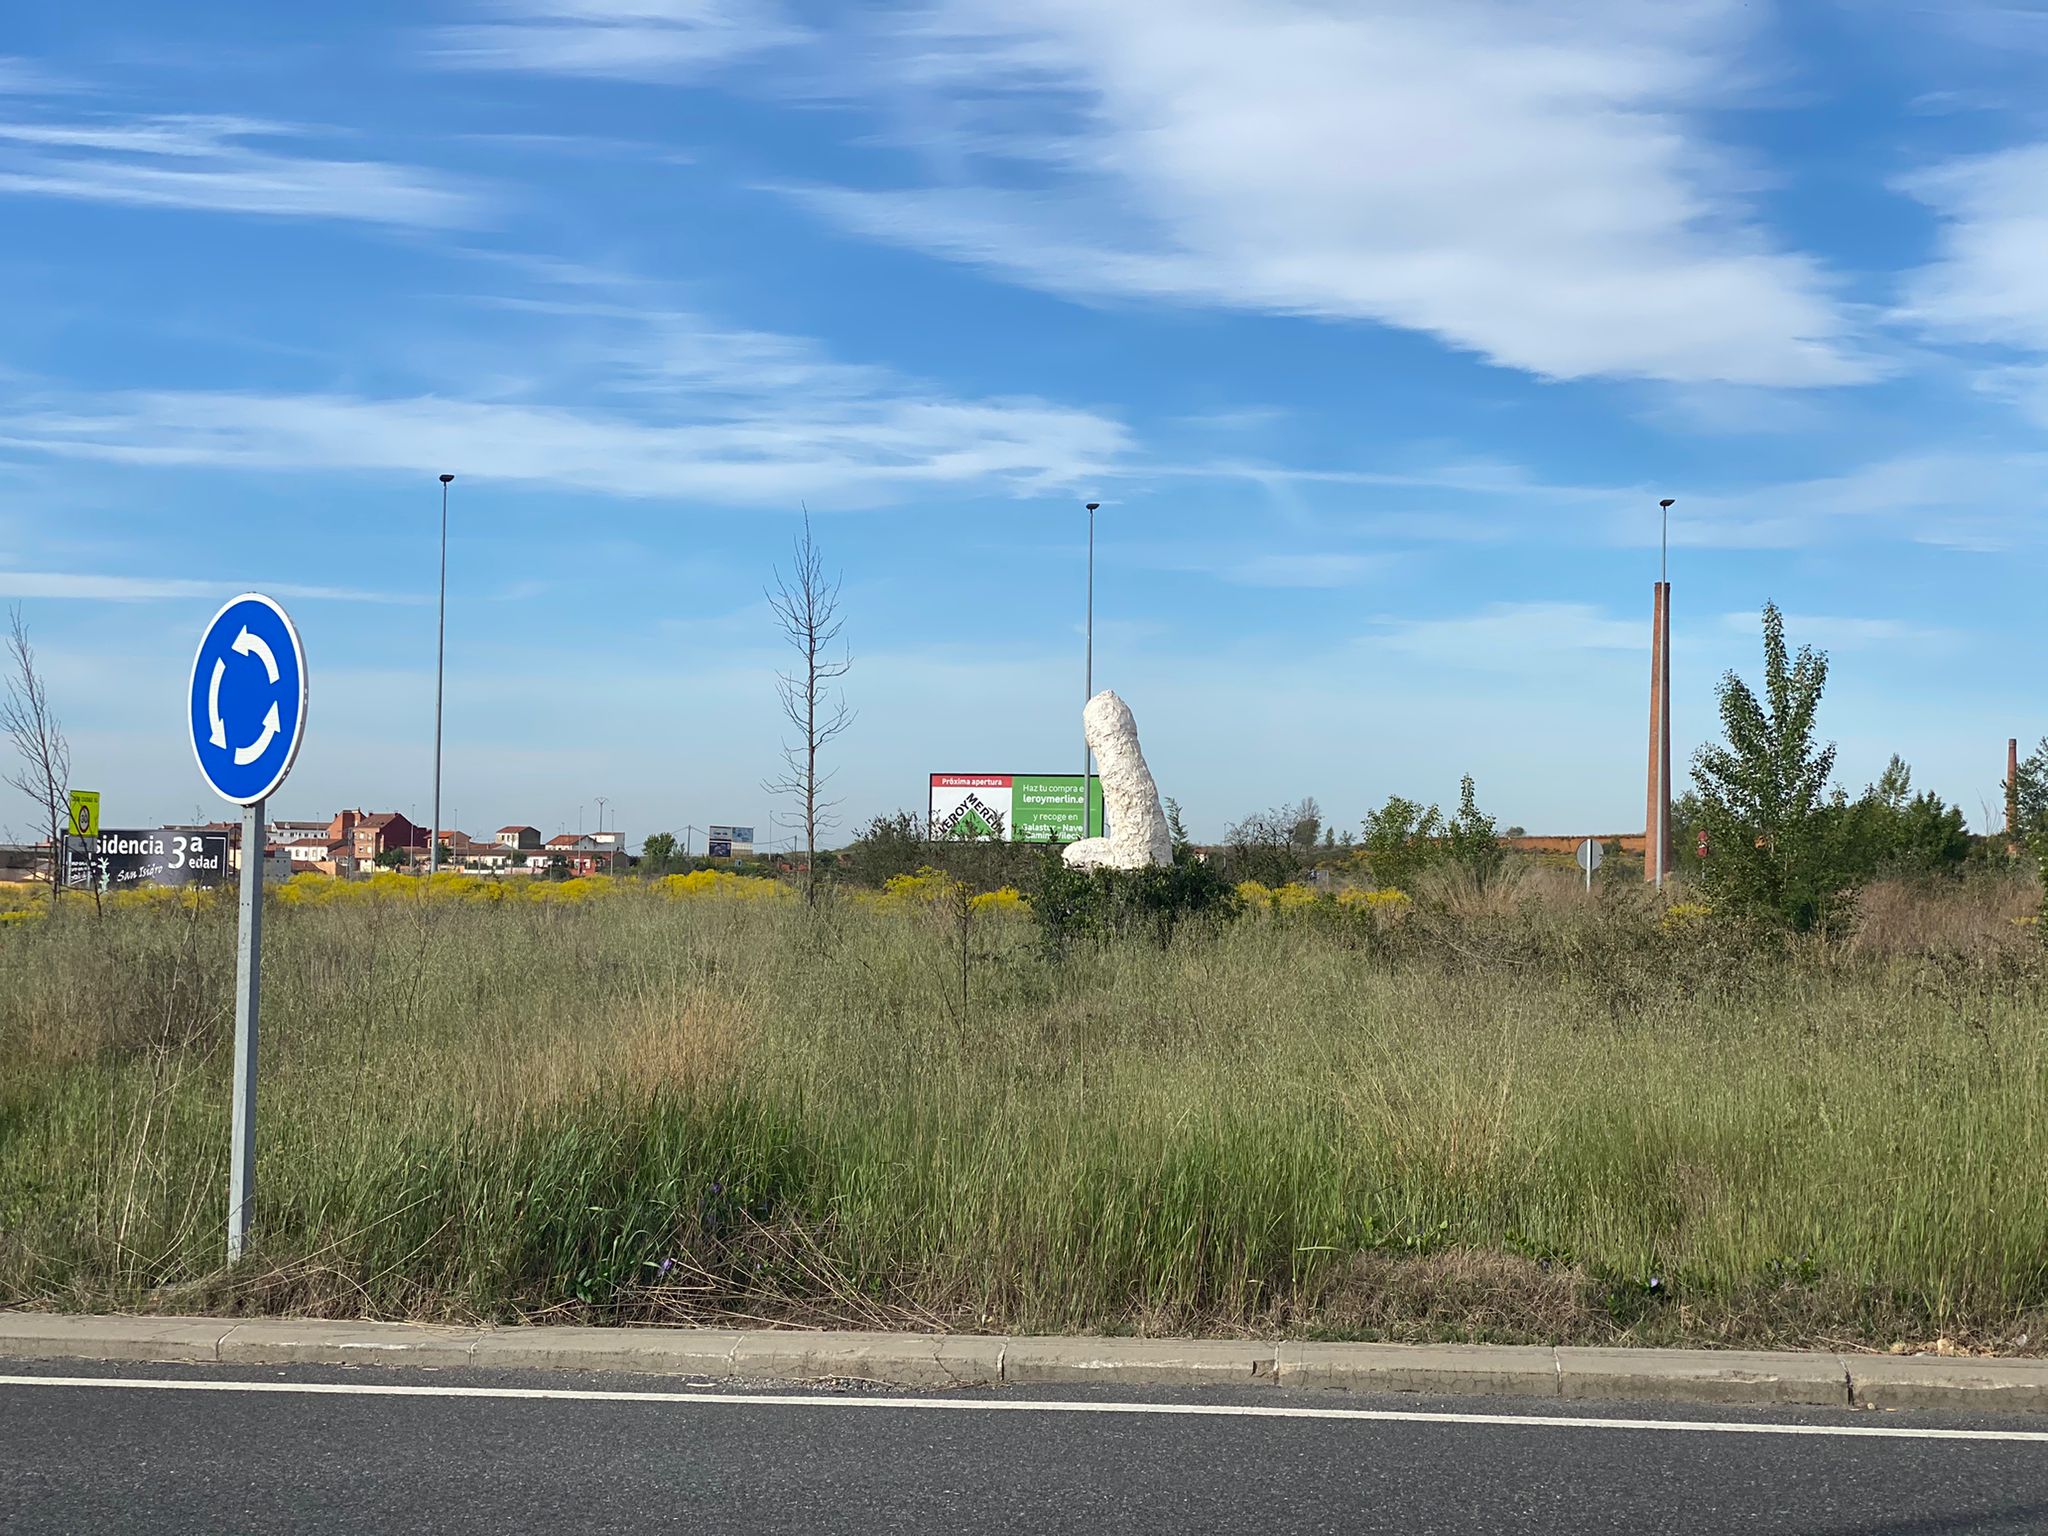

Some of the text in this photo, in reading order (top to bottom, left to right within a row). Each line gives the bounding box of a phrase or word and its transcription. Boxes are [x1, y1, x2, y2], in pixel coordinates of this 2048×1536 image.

[942, 777, 1003, 787] Próxima apertura
[1022, 784, 1038, 792] Haz
[1048, 785, 1078, 793] compra
[1022, 794, 1085, 805] leroymerlin.e
[938, 800, 969, 834] LEROY
[1033, 814, 1038, 822] y
[1039, 813, 1067, 822] recoge
[1062, 824, 1083, 832] Nave
[1025, 831, 1052, 839] Camin
[96, 834, 165, 855] sidencia
[188, 855, 218, 869] edad
[116, 862, 164, 882] San Isidro
